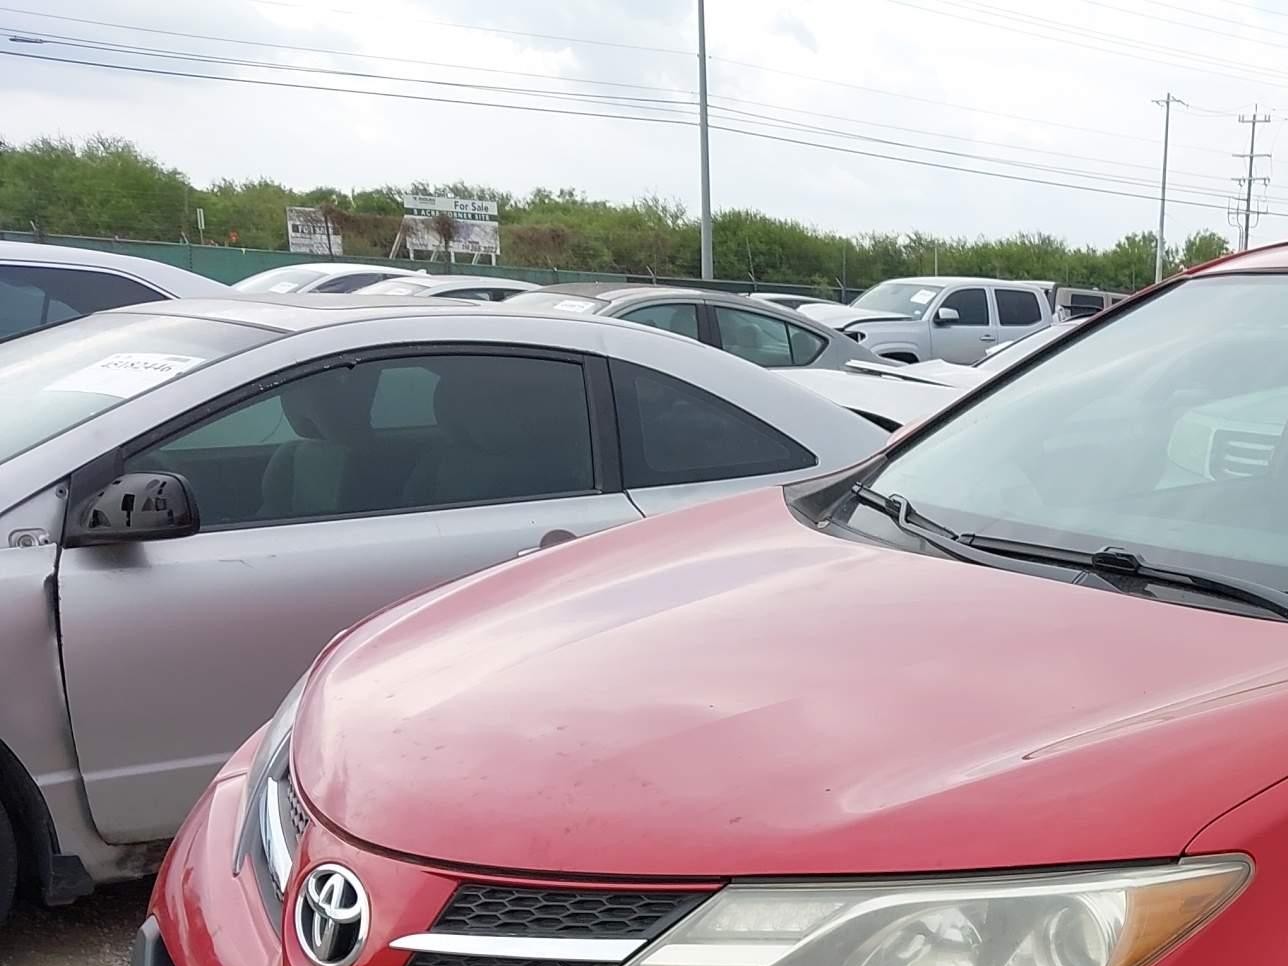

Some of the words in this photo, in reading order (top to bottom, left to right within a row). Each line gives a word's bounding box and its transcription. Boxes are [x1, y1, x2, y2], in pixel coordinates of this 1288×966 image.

[454, 201, 468, 210] For
[471, 202, 489, 212] Sale
[441, 211, 472, 219] ORNER
